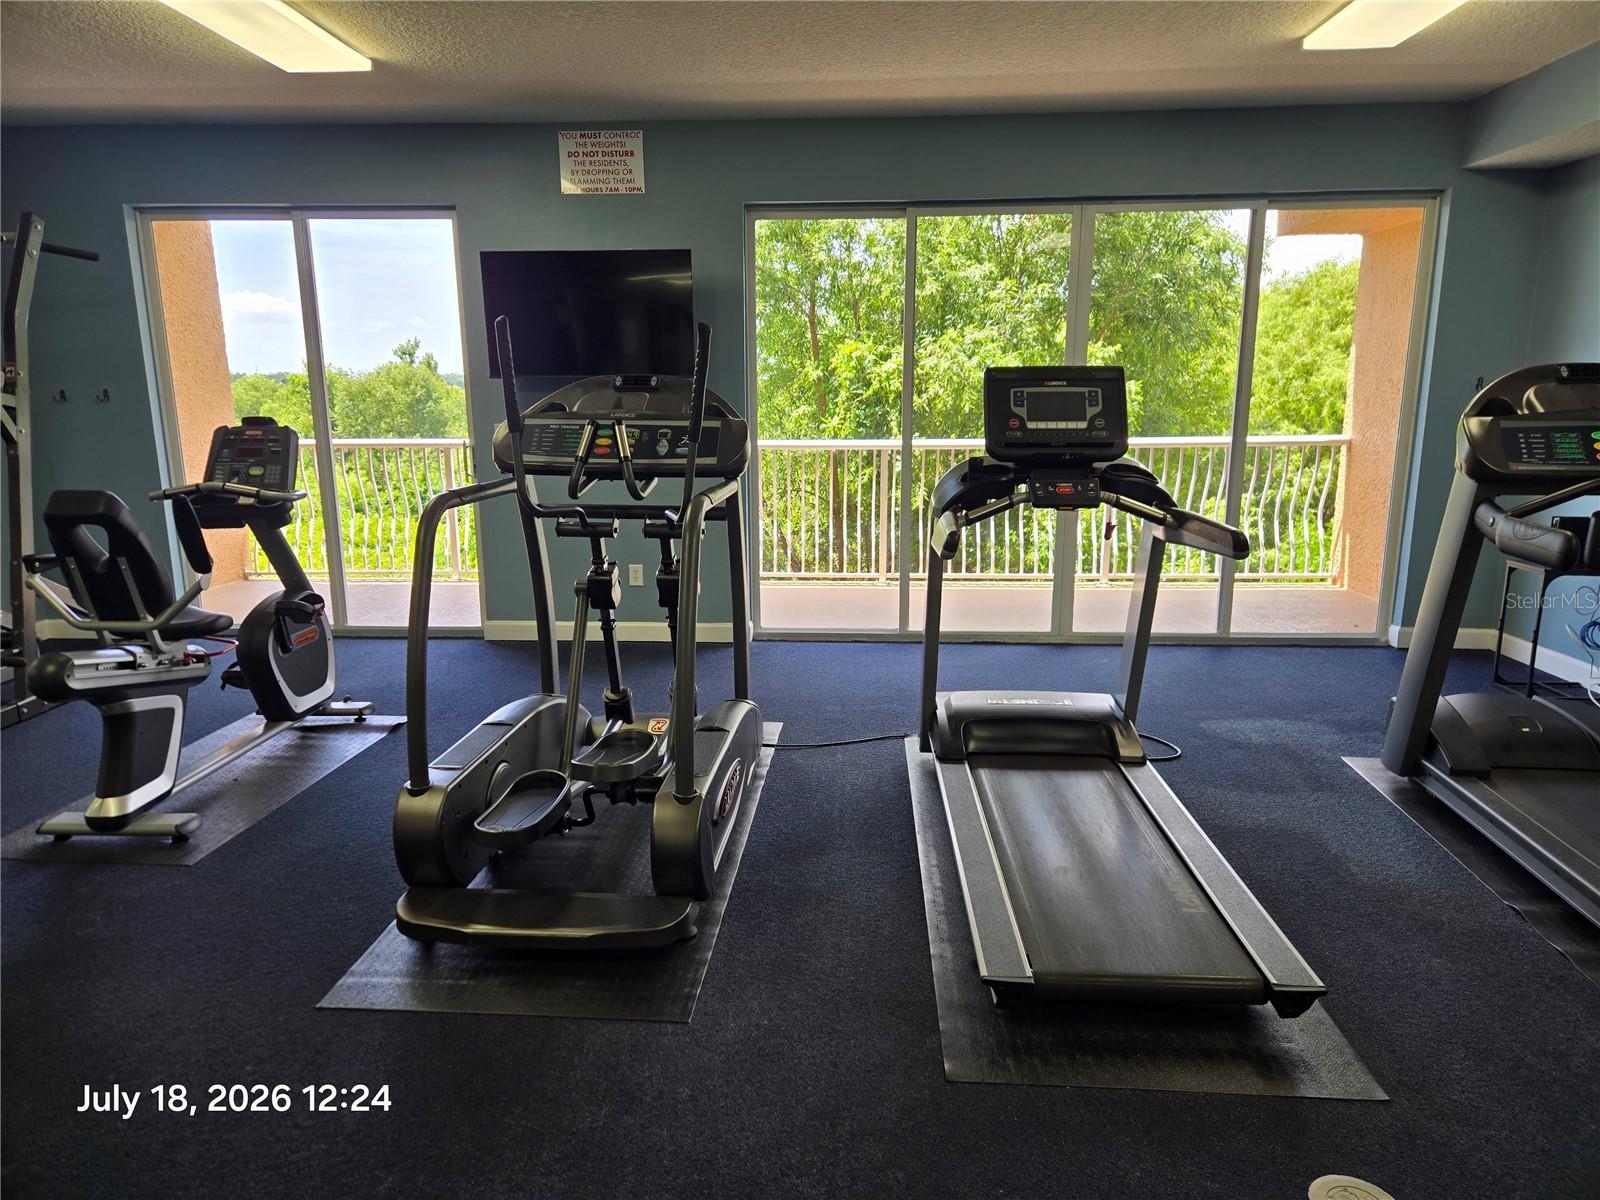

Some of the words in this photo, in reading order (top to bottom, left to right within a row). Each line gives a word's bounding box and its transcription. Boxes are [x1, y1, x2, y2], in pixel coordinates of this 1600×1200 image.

[575, 141, 588, 149] THE
[590, 141, 626, 149] WEIGHTS!
[589, 160, 630, 168] RESIDENTS,
[622, 168, 633, 176] OR
